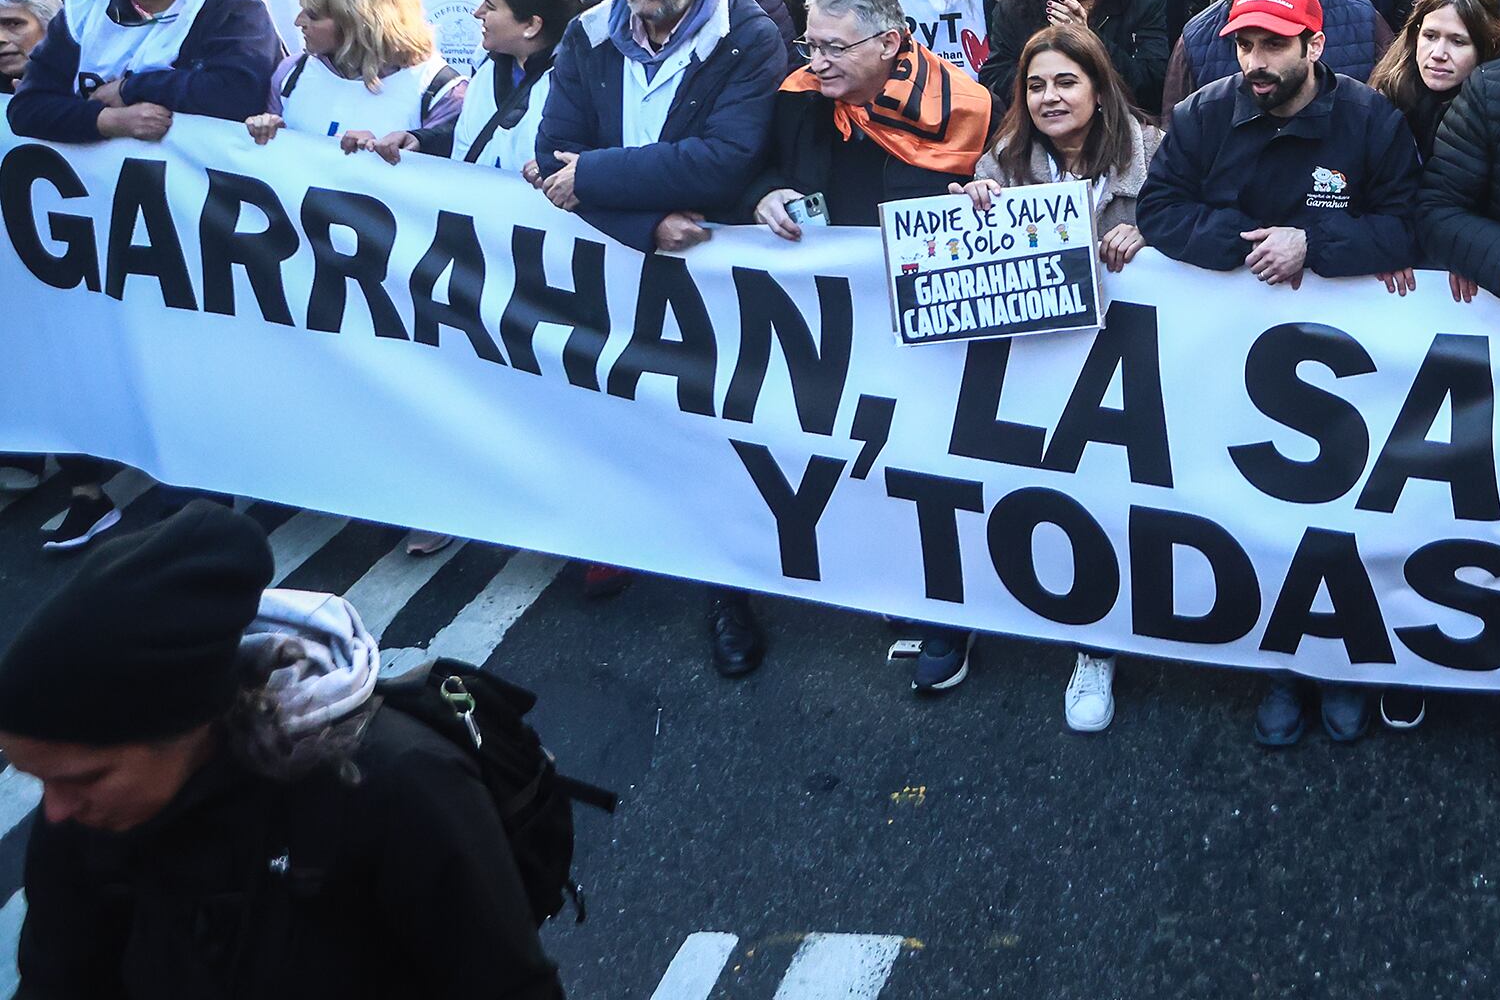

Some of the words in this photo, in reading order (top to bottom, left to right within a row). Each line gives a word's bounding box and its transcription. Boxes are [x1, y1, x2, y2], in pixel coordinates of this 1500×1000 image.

[893, 206, 965, 241] NADIE
[971, 202, 998, 232] SE
[1005, 194, 1079, 229] SALVA
[1305, 197, 1349, 209] Garrahan
[962, 230, 1015, 261] SOLO
[913, 257, 1037, 306] GARRAHAN
[1036, 254, 1066, 287] ES
[3, 143, 898, 482] GARRAHAN,
[947, 303, 1176, 489] LA
[902, 300, 978, 339] CAUSA
[976, 283, 1087, 329] NACIONAL
[726, 437, 848, 582] Y
